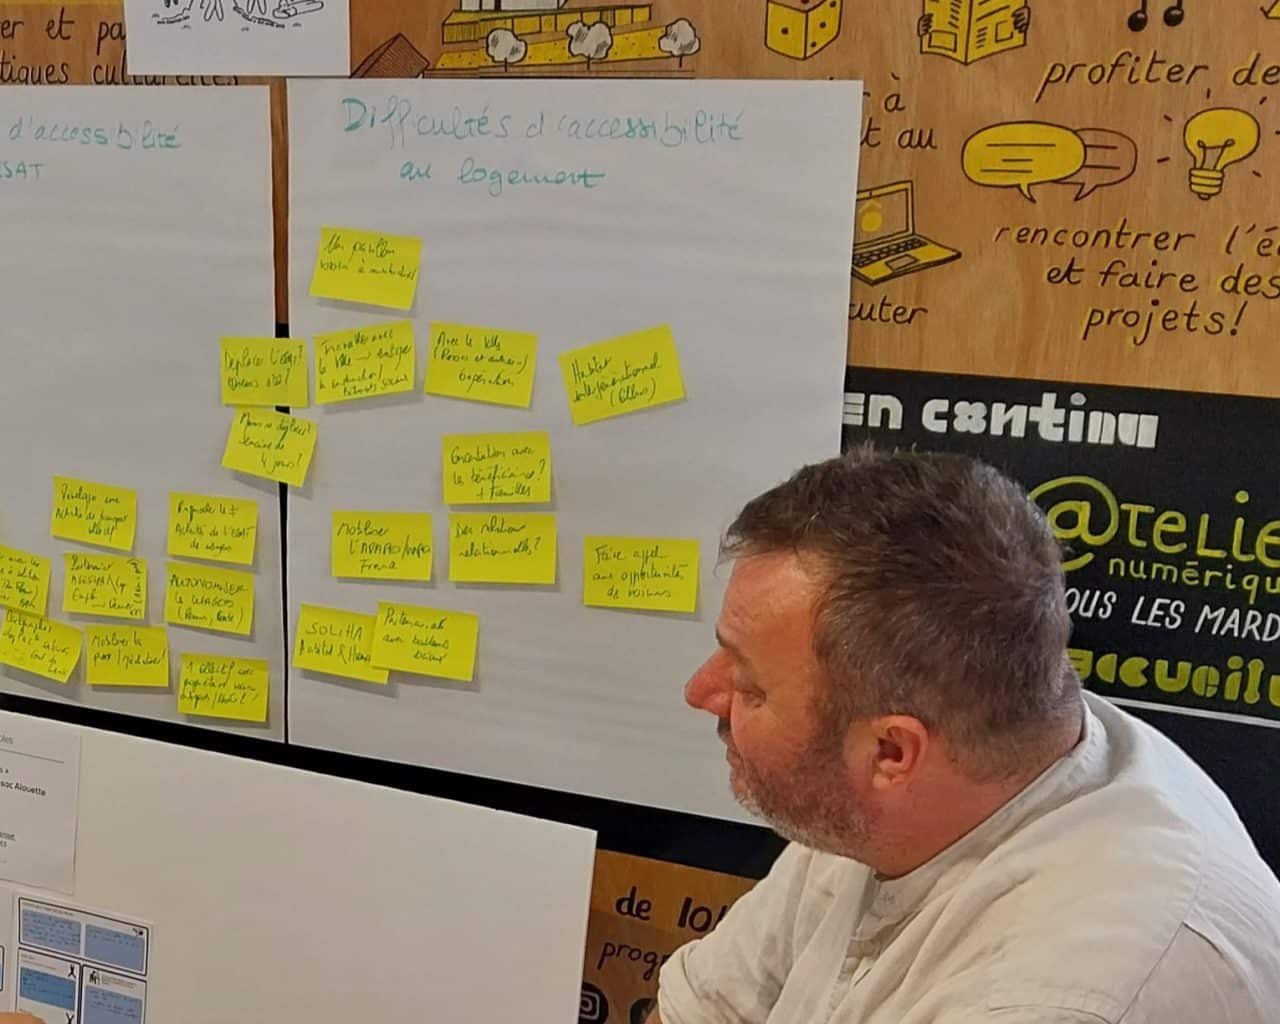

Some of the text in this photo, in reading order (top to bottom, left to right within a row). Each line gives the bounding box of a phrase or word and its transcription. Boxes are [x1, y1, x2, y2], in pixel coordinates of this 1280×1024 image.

[45, 10, 78, 39] et
[96, 19, 127, 52] pa
[884, 72, 906, 113] à
[1036, 50, 1209, 104] profiter
[342, 96, 746, 149] Difficultés d'accessibilité
[860, 117, 937, 149] t au
[400, 156, 606, 197] au logement
[995, 218, 1280, 257] rencontrer l'é
[1047, 258, 1280, 299] et faire des
[848, 296, 928, 325] cuter
[1083, 299, 1248, 346] projets!
[1109, 557, 1280, 605] numériqu
[1064, 587, 1280, 642] OUS LES MARD
[616, 886, 728, 932] de lo
